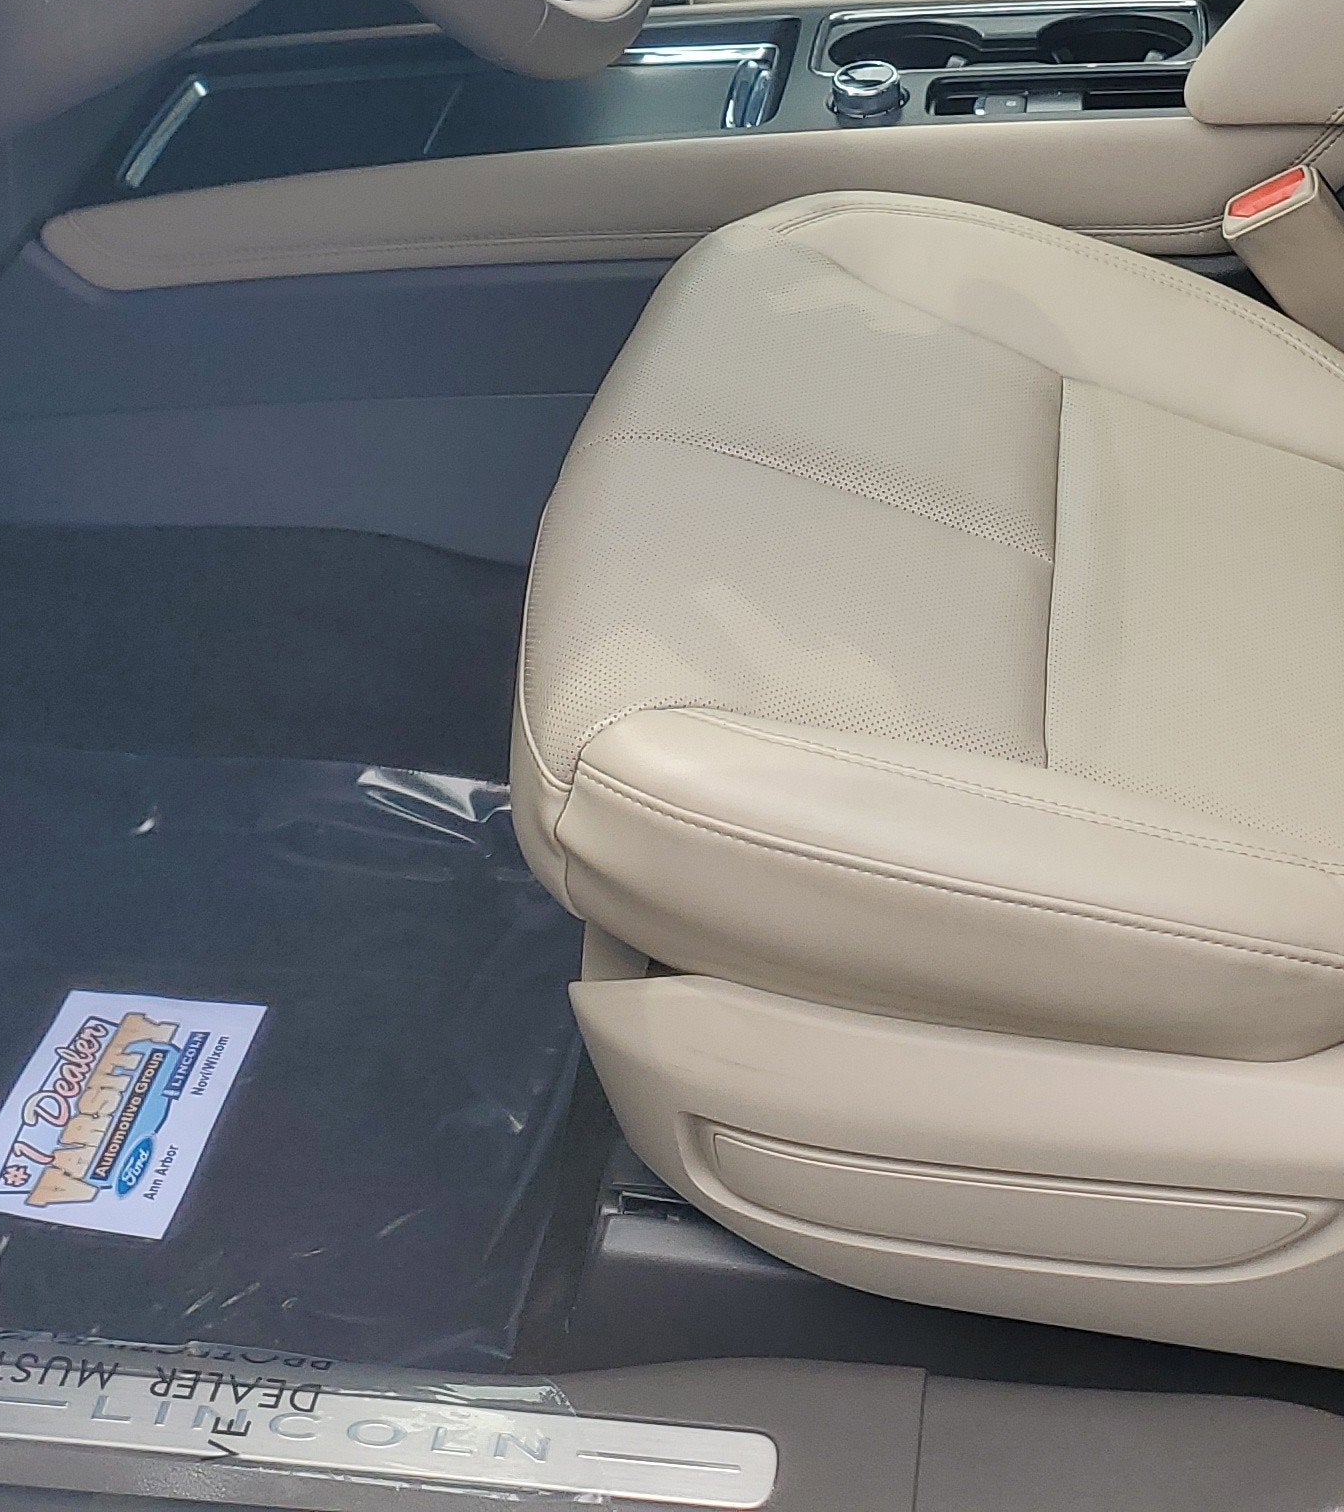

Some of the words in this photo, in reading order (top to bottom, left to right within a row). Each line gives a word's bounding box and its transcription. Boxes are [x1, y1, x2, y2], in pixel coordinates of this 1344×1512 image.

[22, 1021, 110, 1128] Dealer
[171, 1031, 210, 1088] LINCOLN
[190, 1034, 231, 1097] Novi/Wixom
[25, 1012, 180, 1208] VARSITY
[96, 1097, 142, 1178] Automotive
[134, 1051, 166, 1093] Group
[1, 1140, 55, 1188] #1
[120, 1147, 151, 1187] Ford
[142, 1178, 164, 1201] Ann
[157, 1143, 180, 1177] Arbor
[149, 1366, 325, 1414] DEALER
[90, 1395, 553, 1465] LINCOLN
